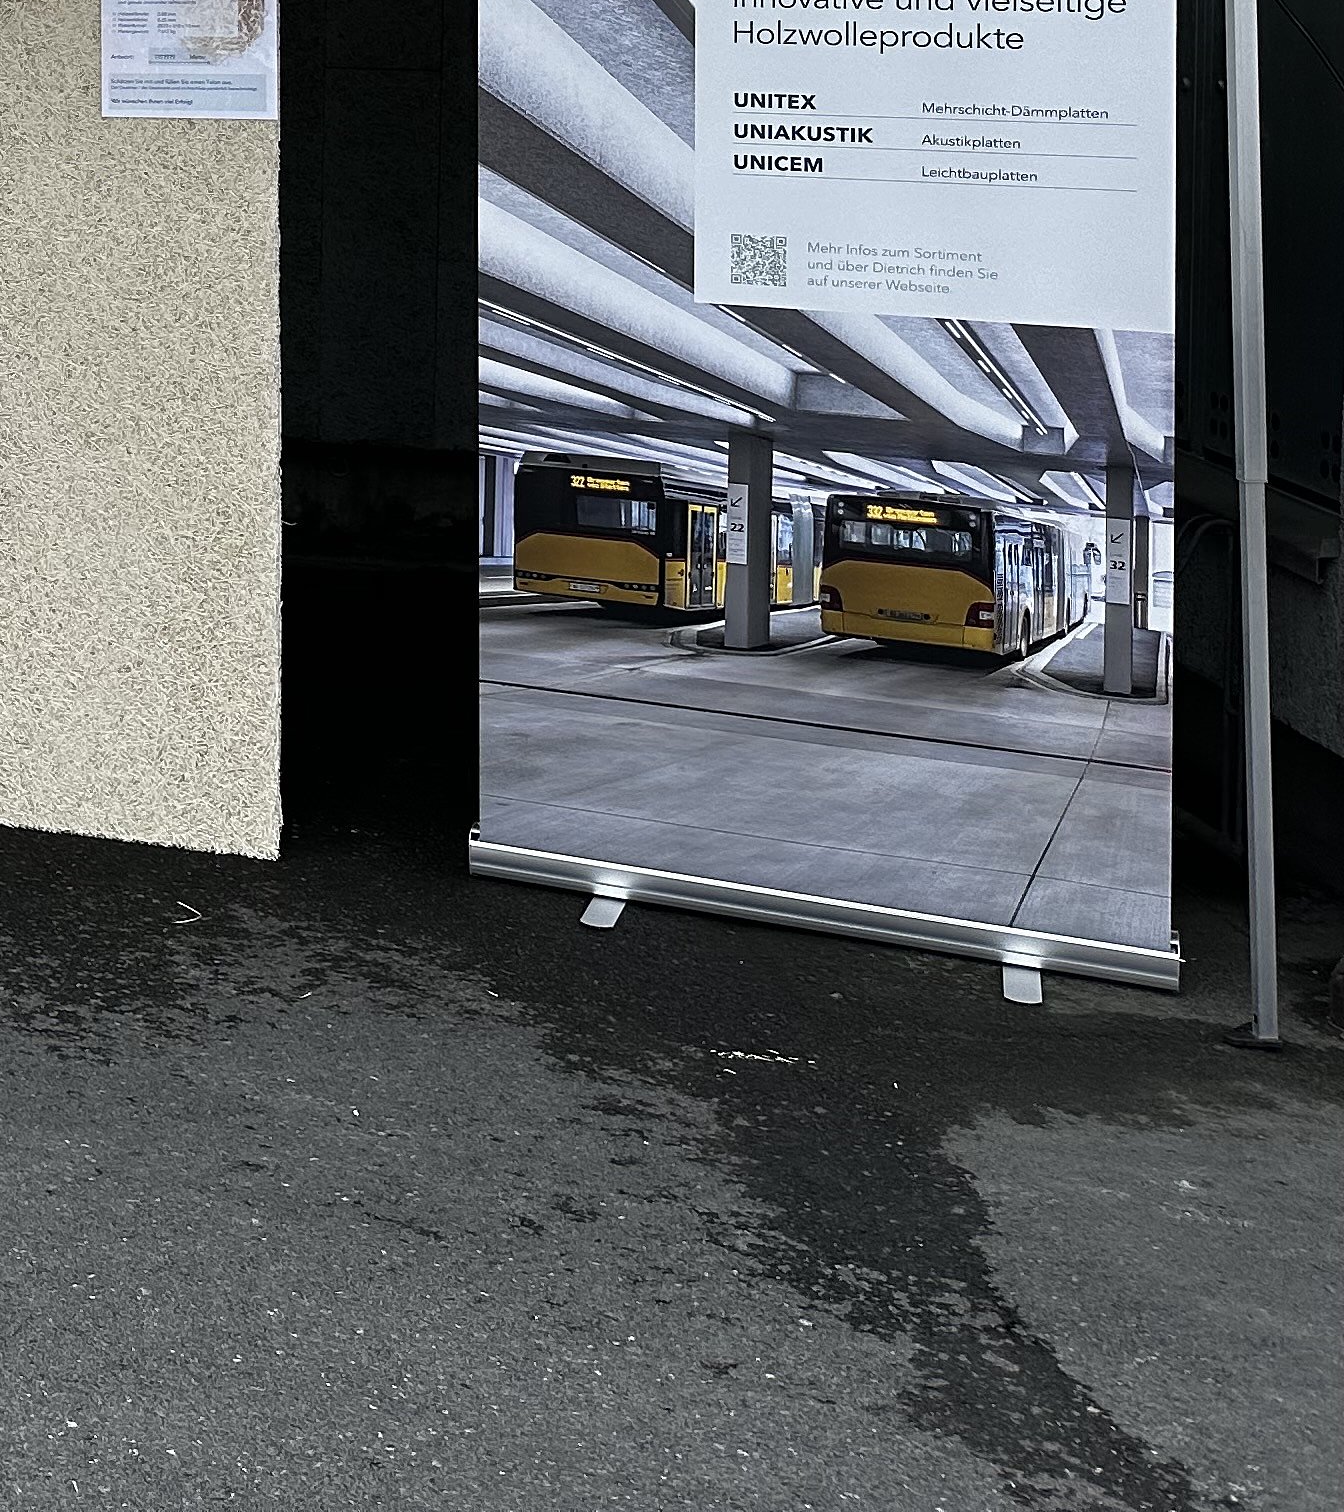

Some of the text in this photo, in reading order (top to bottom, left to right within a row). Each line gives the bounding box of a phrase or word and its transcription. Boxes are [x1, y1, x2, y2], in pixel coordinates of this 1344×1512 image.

[733, 21, 1025, 54] Holzwolleprodukte
[734, 92, 1109, 121] UNITEX Mehrschicht-Dämmplatten
[734, 123, 1021, 150] UNIAKUSTIK Akustikplatten
[734, 154, 1038, 183] UNICEM Leichtbauplatten
[807, 242, 982, 262] Mehr Infos zum Sortiment
[807, 260, 999, 280] und über Dietrich finden Sie
[807, 275, 829, 287] auf
[832, 279, 882, 290] unserer
[730, 522, 745, 533] 22
[1109, 560, 1126, 570] 32
